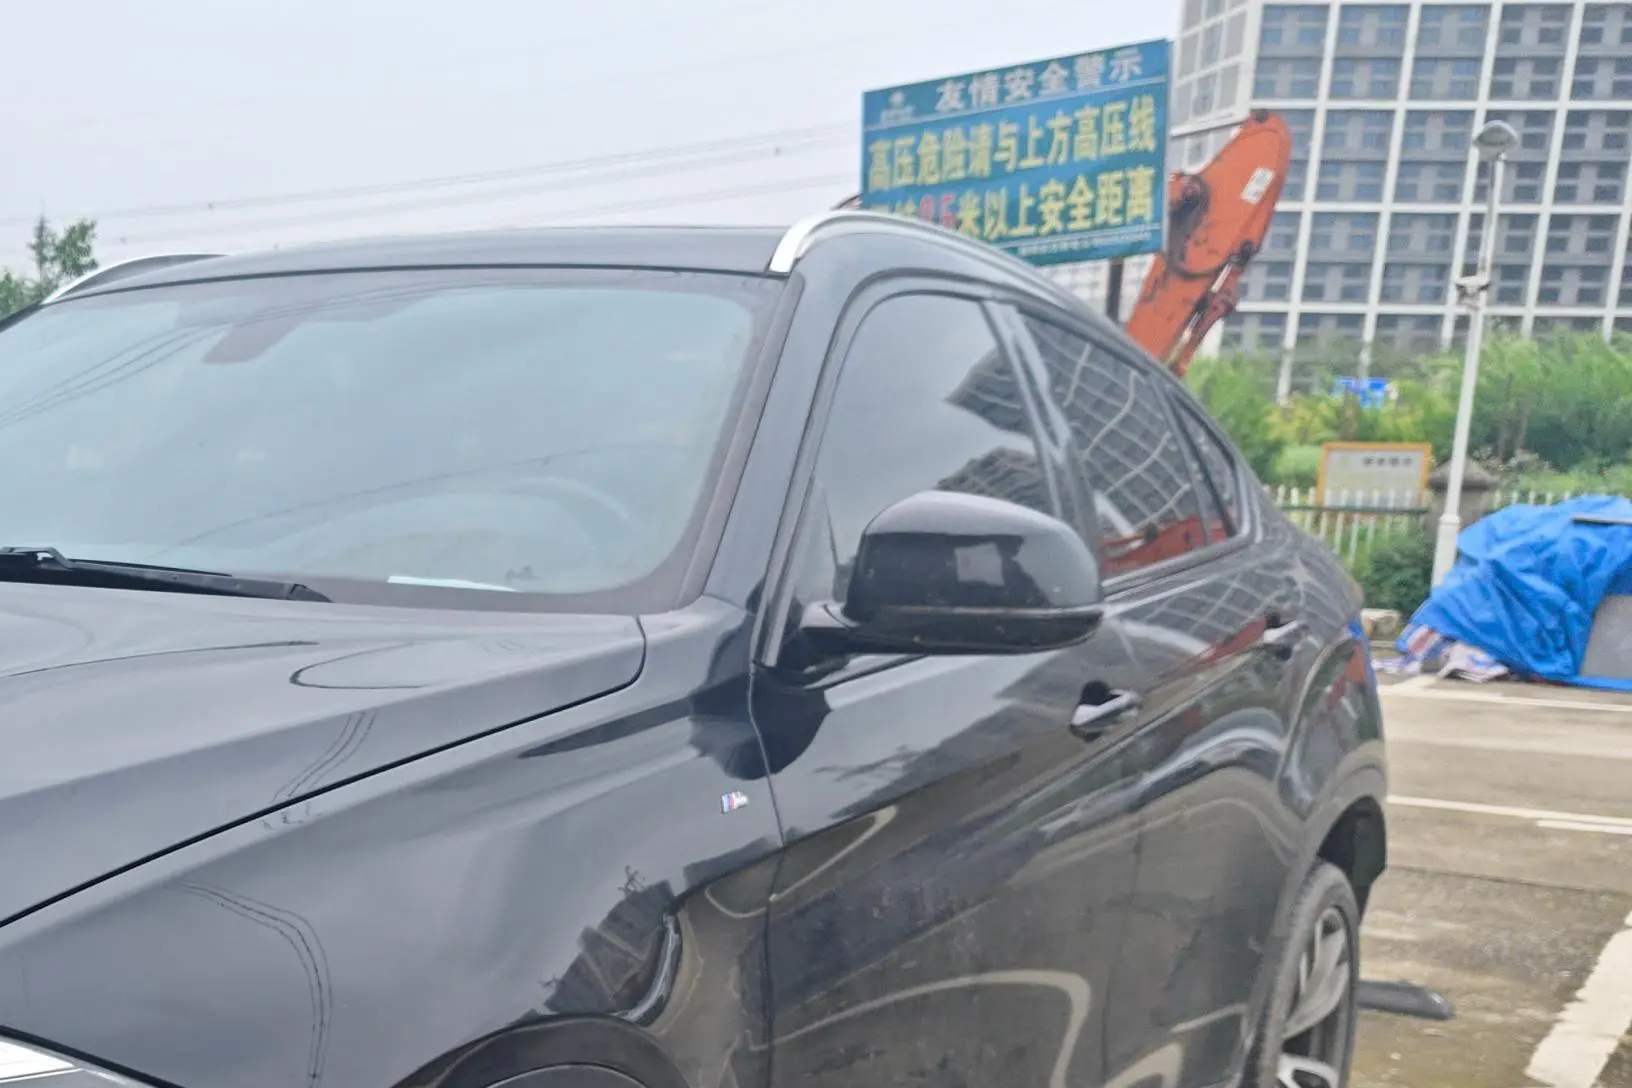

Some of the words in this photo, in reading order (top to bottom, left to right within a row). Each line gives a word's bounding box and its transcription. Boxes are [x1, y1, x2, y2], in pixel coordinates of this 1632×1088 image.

[935, 48, 1143, 112] 友情安全警示
